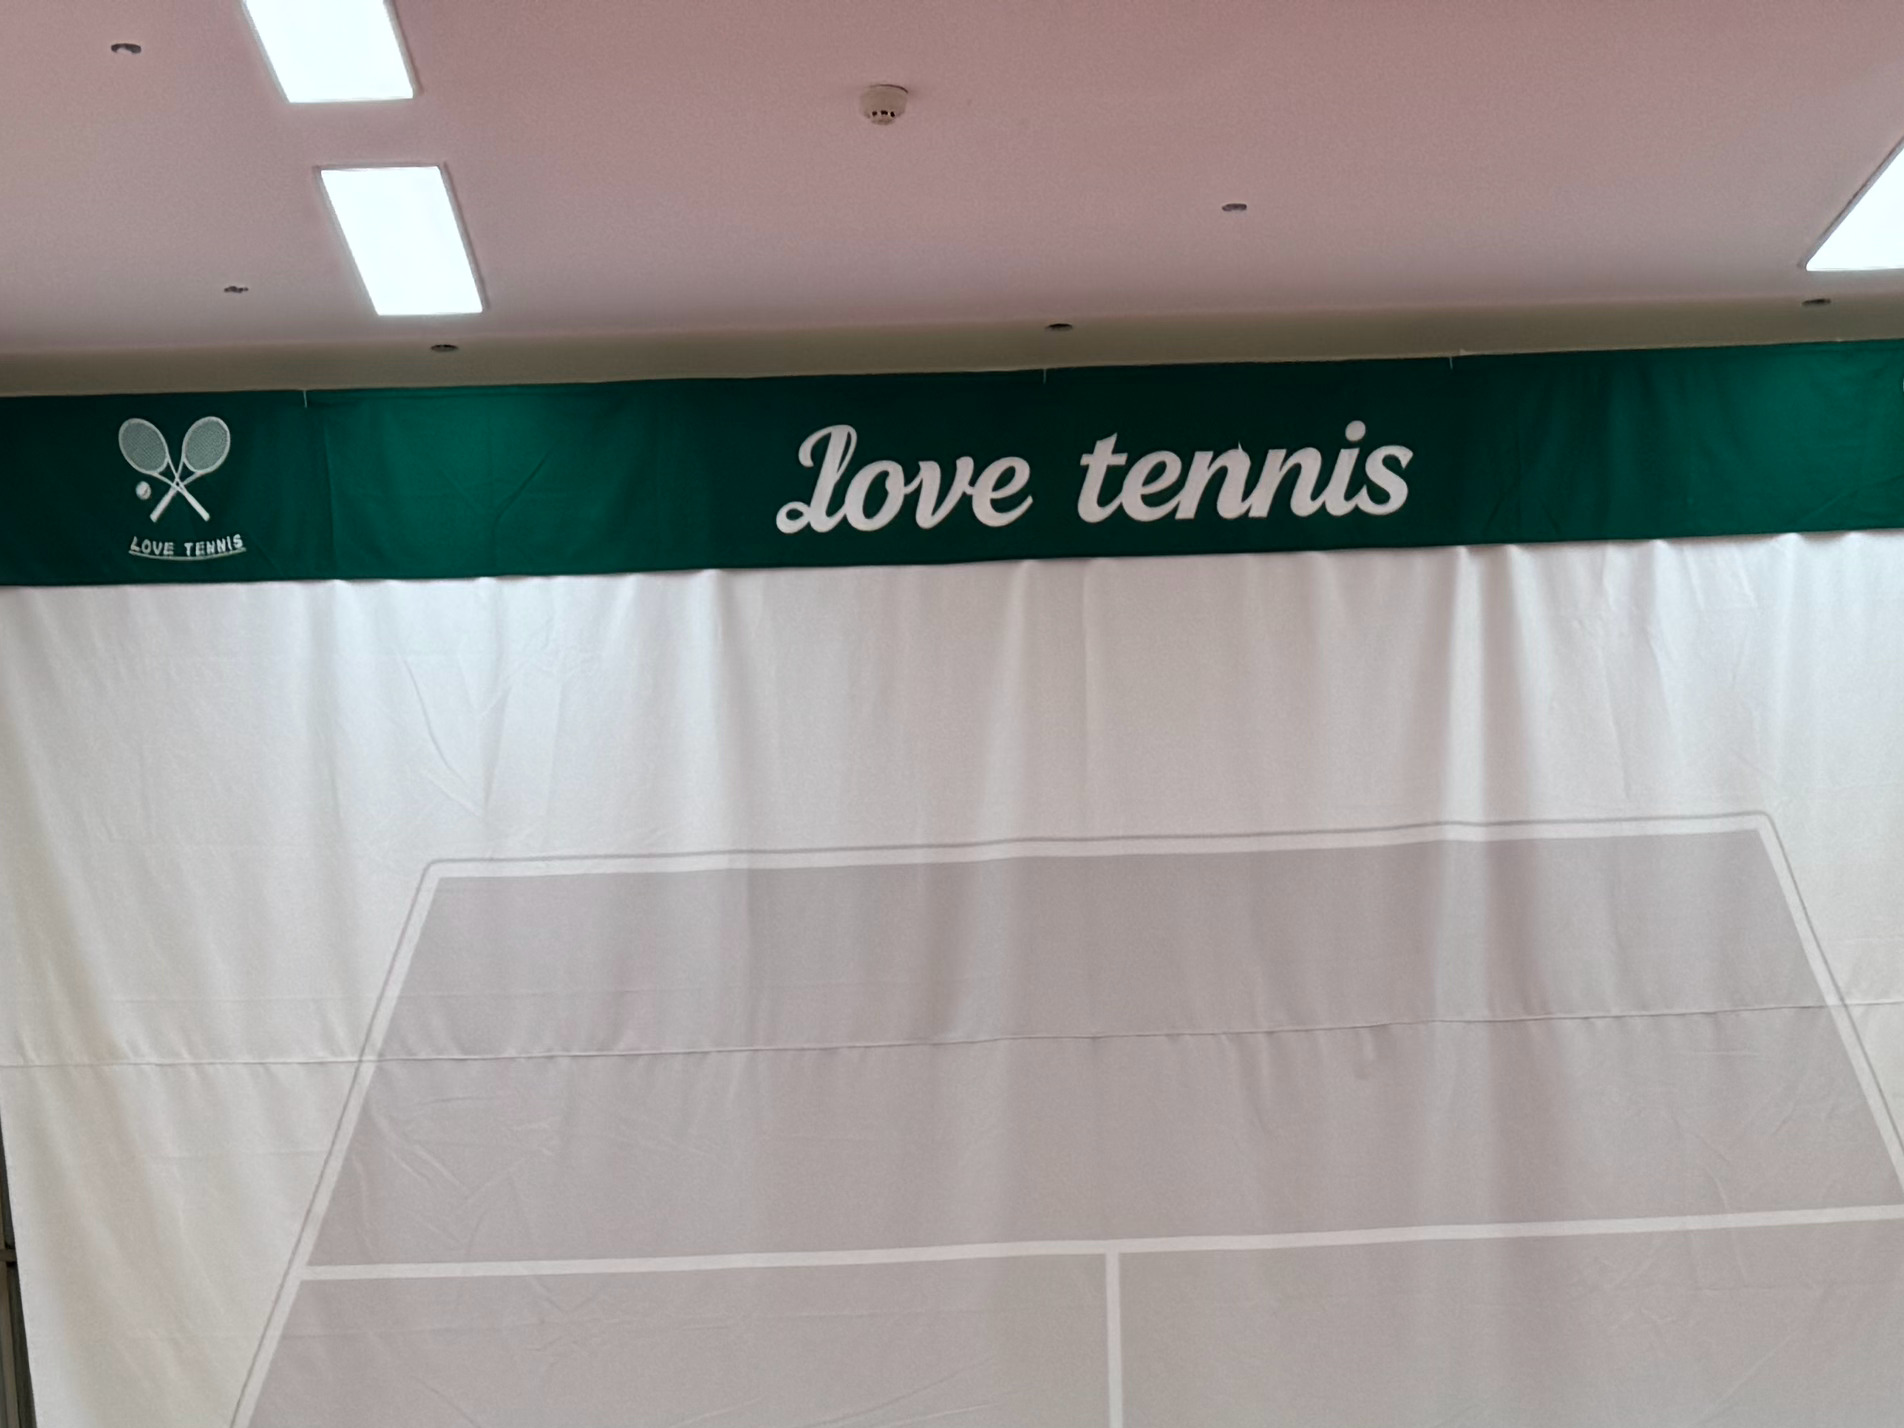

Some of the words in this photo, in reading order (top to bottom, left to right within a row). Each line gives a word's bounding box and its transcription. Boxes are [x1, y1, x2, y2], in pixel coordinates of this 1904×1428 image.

[1076, 420, 1414, 523] tennis
[130, 535, 175, 556] LOVE
[183, 533, 244, 557] TENNIS
